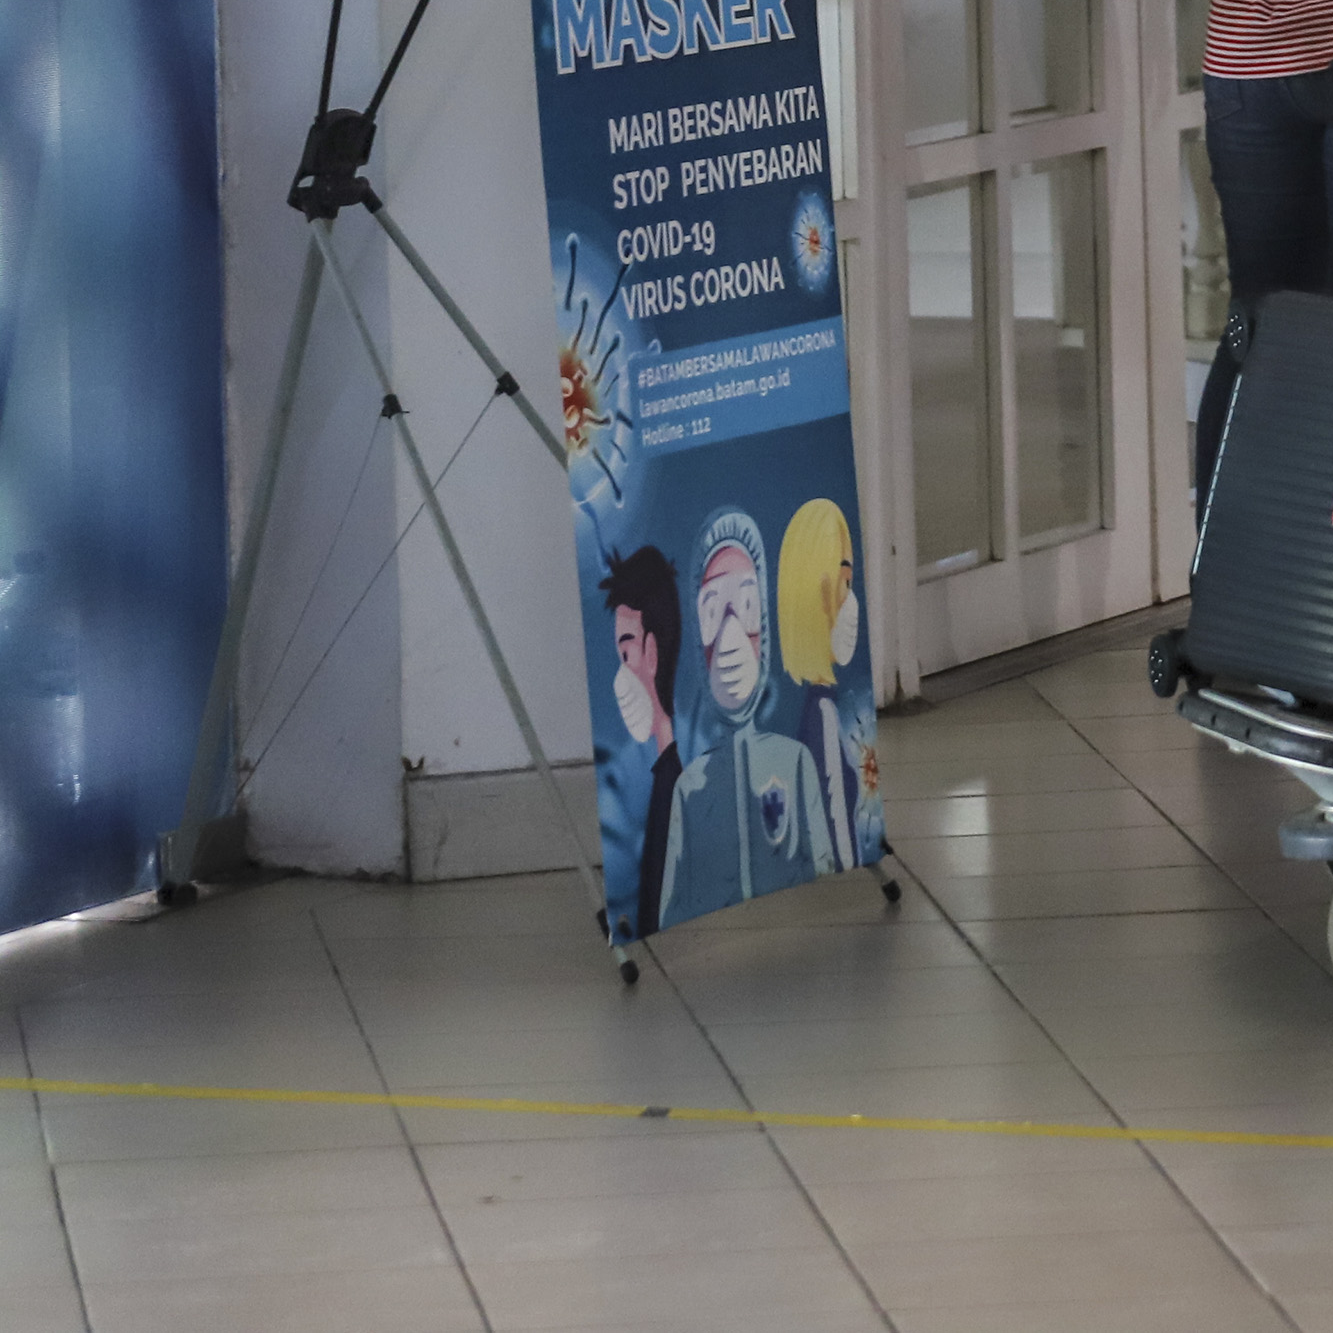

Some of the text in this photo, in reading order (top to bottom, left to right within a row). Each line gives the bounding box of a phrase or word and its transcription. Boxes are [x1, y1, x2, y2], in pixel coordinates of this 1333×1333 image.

[608, 85, 820, 154] MARI BERSAMA KITA
[613, 139, 823, 209] STOP PENYEBARAN
[617, 220, 716, 265] COVID-19
[621, 256, 785, 320] VIRUS CORONA
[638, 329, 836, 389] #BATAMBERSAMALAWANCORONA
[639, 367, 791, 418] lawancorona.batam.go.id
[641, 422, 684, 446] Hotline
[691, 417, 712, 436] 112
